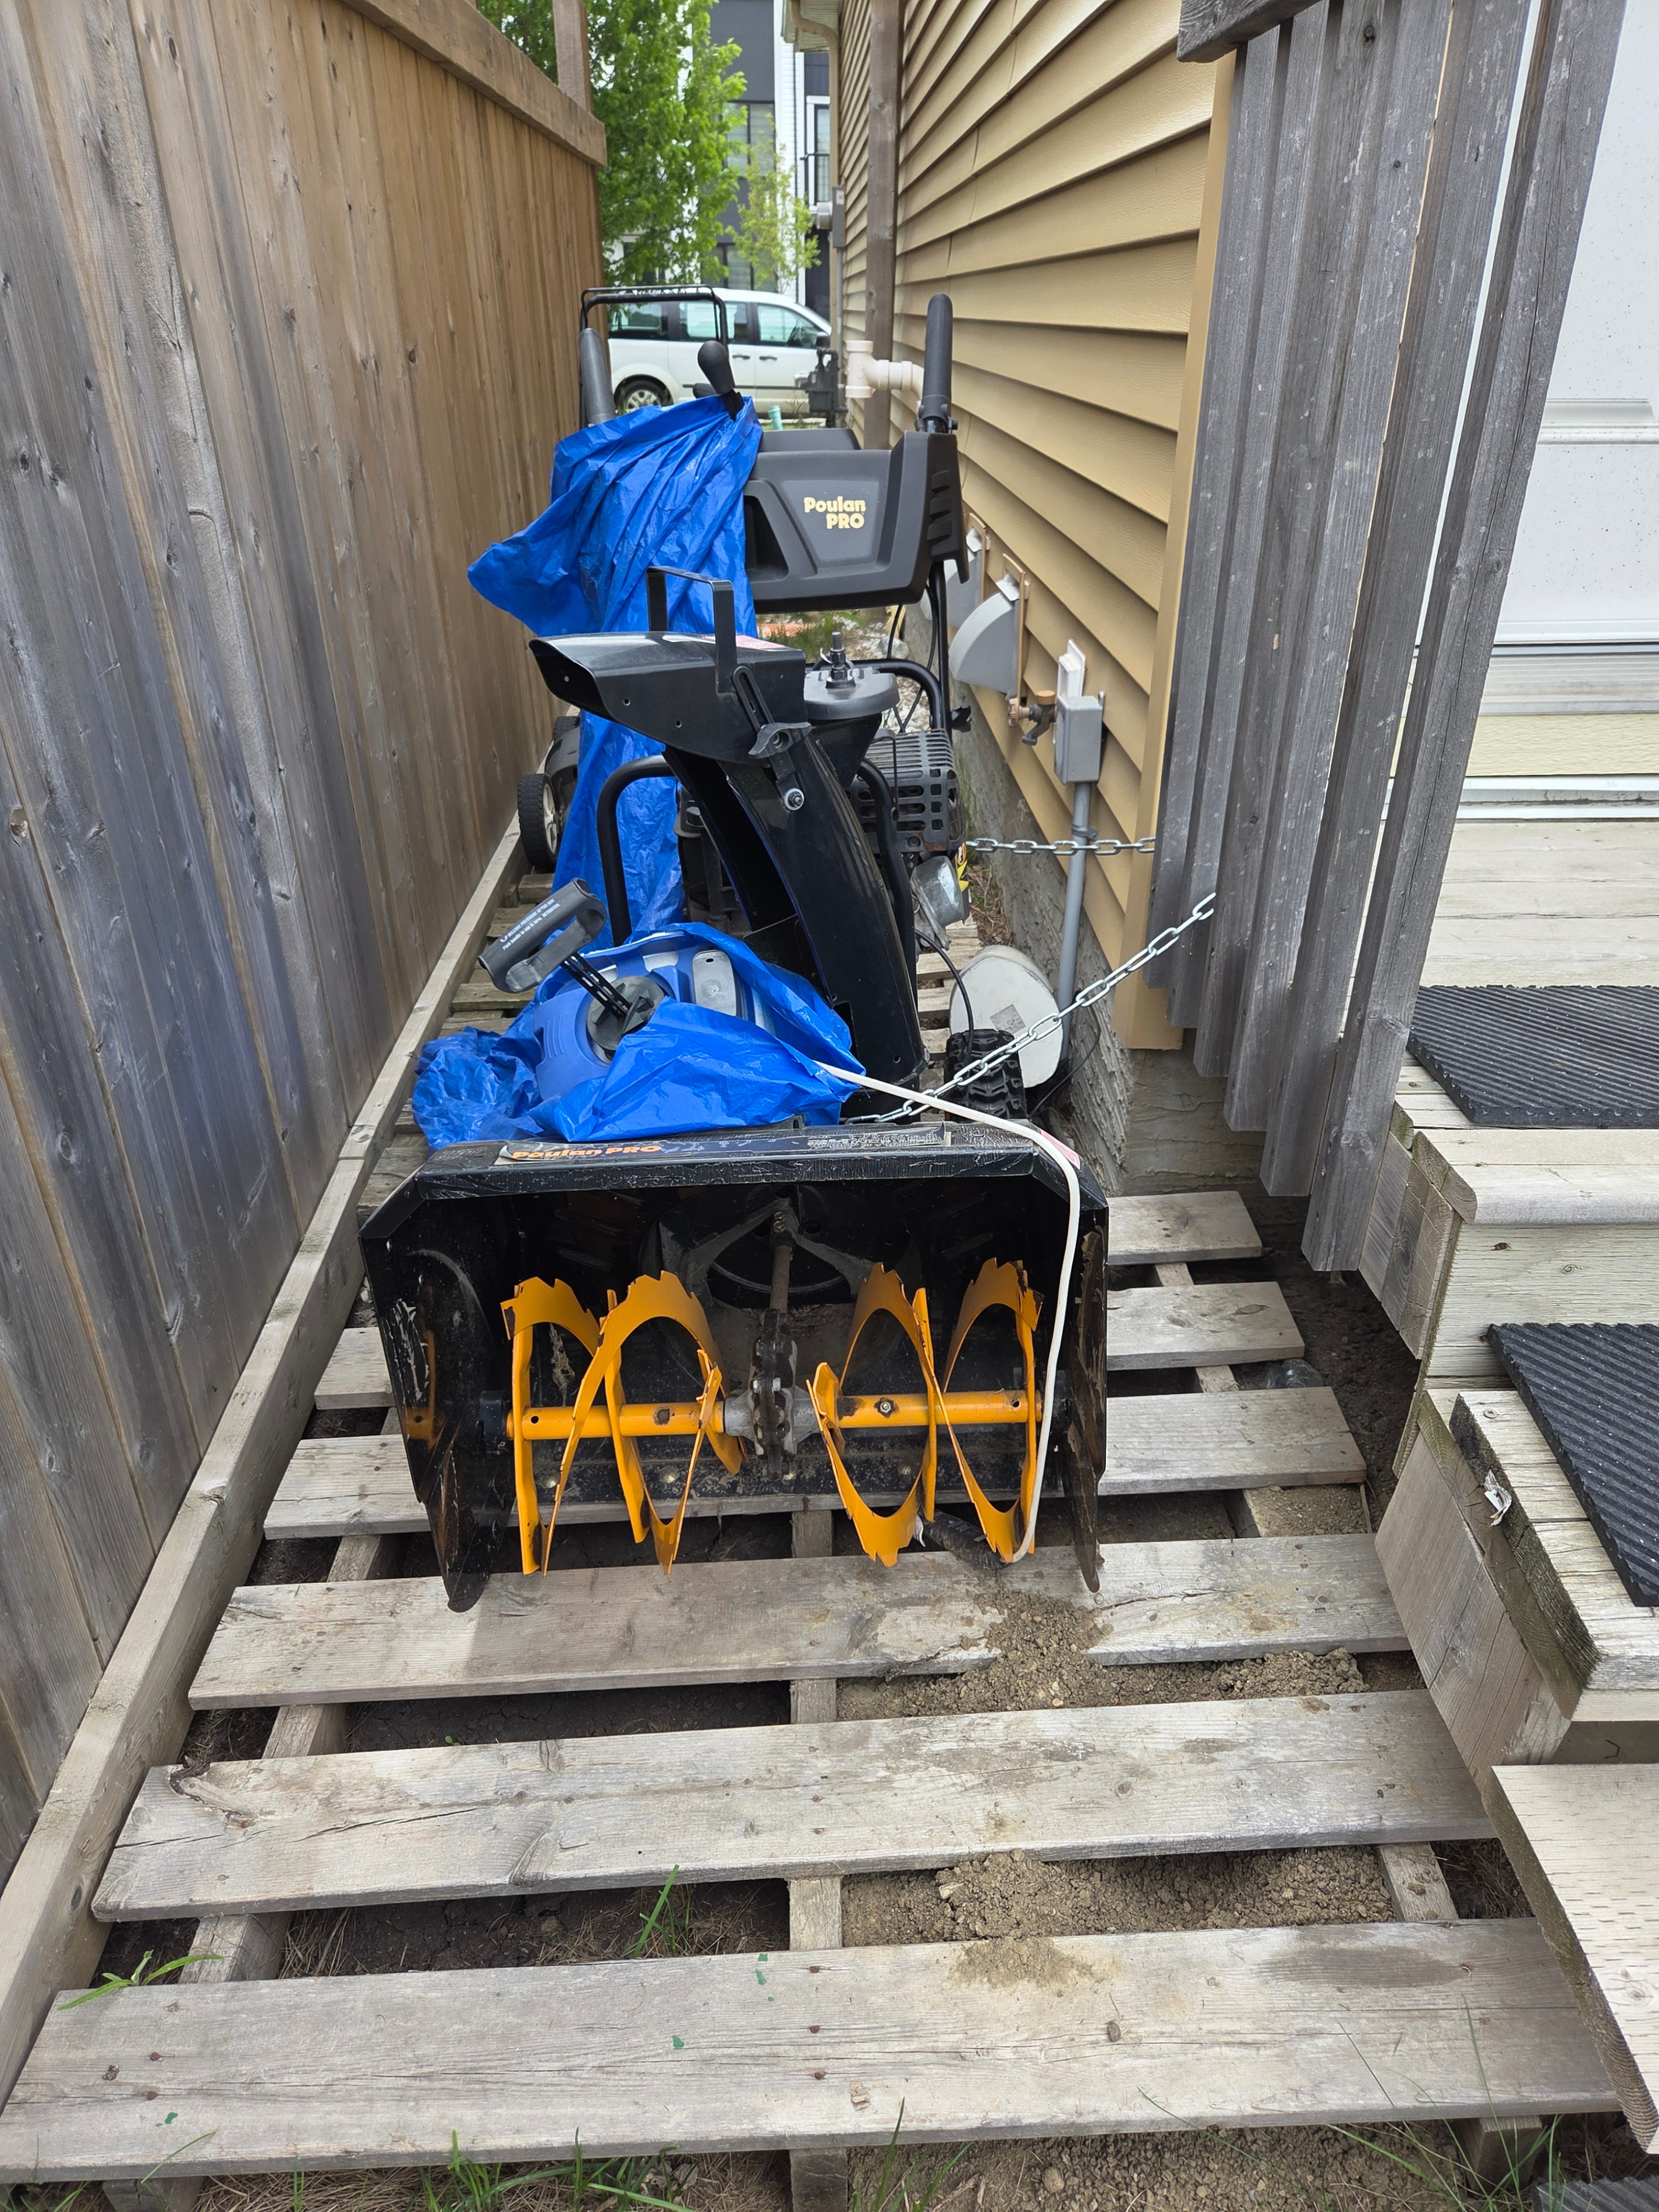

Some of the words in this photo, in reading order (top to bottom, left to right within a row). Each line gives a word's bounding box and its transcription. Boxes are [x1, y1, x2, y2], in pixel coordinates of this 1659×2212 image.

[803, 496, 866, 513] Poulan
[826, 513, 864, 529] PRO
[512, 1149, 602, 1159] Poulan
[605, 1146, 662, 1154] PRO
